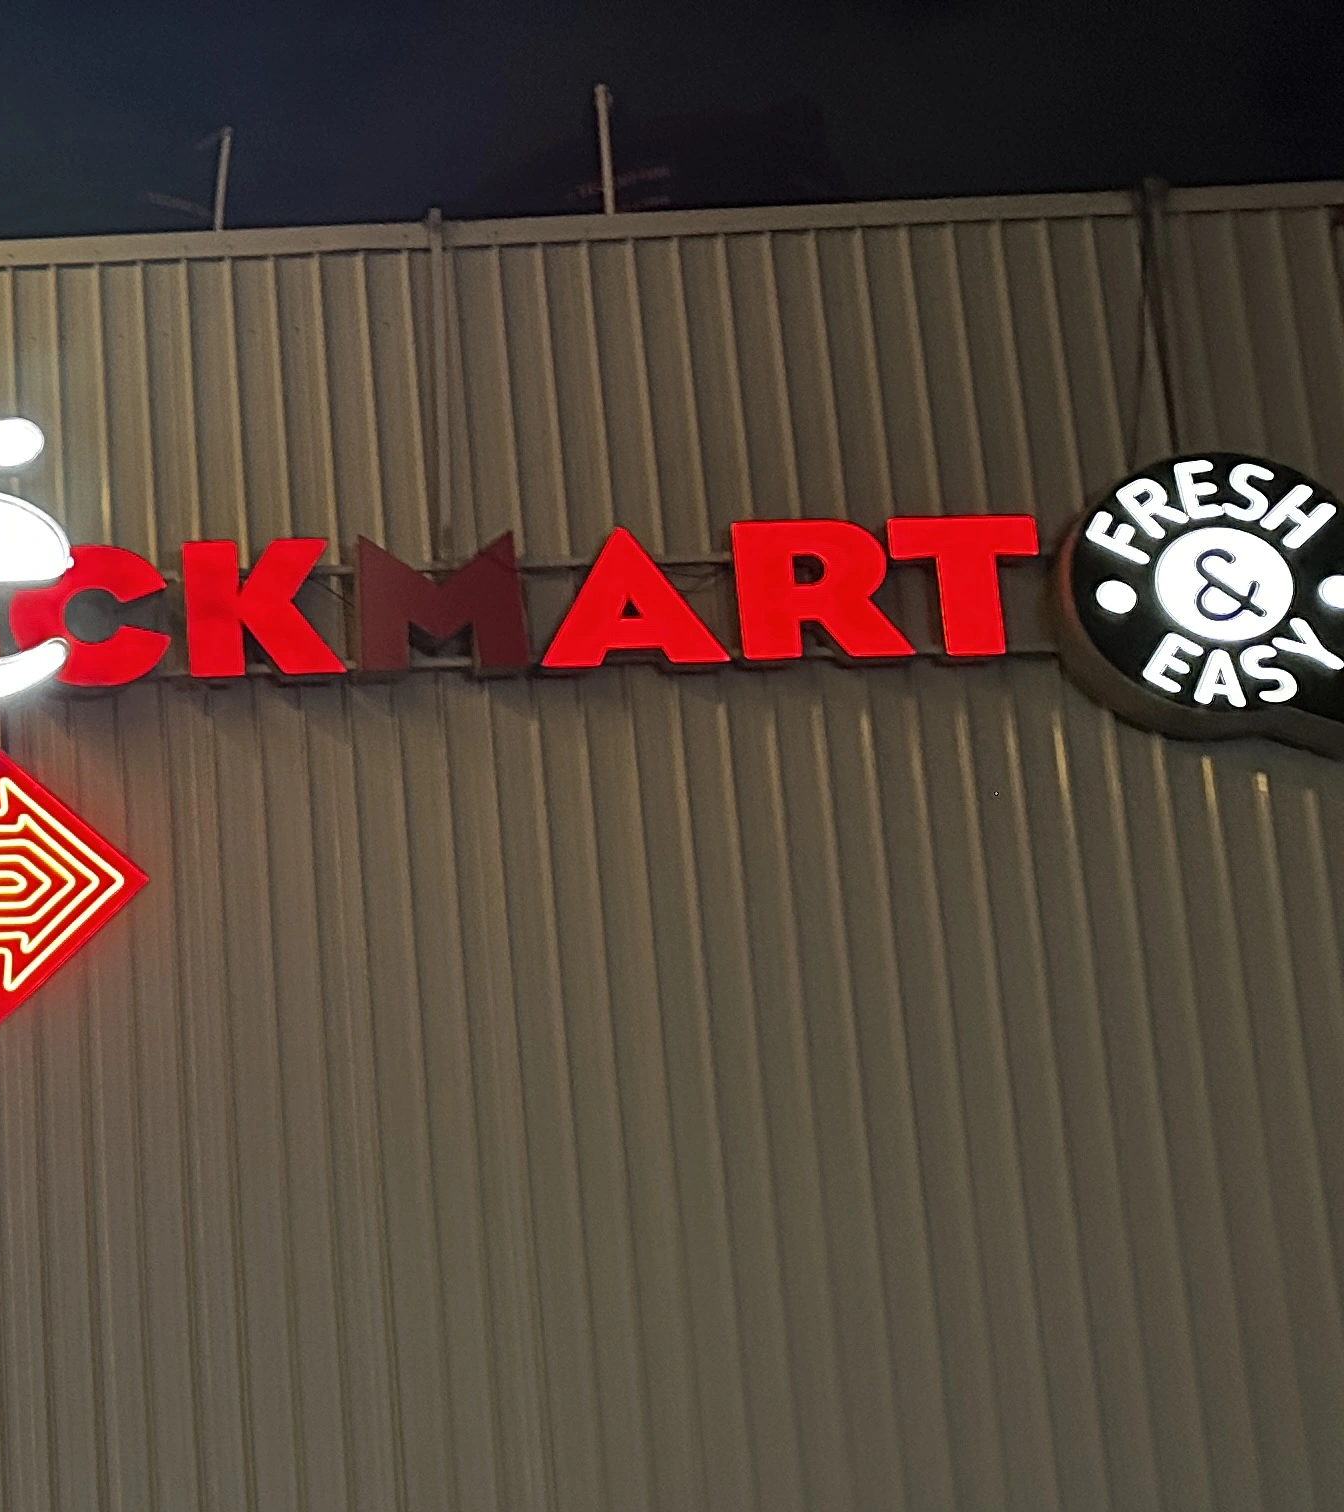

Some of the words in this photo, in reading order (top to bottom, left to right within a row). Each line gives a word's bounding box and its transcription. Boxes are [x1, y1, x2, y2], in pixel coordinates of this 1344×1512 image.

[1085, 459, 1337, 566] FRESH
[1195, 547, 1268, 622] &
[1142, 616, 1344, 709] EASY
